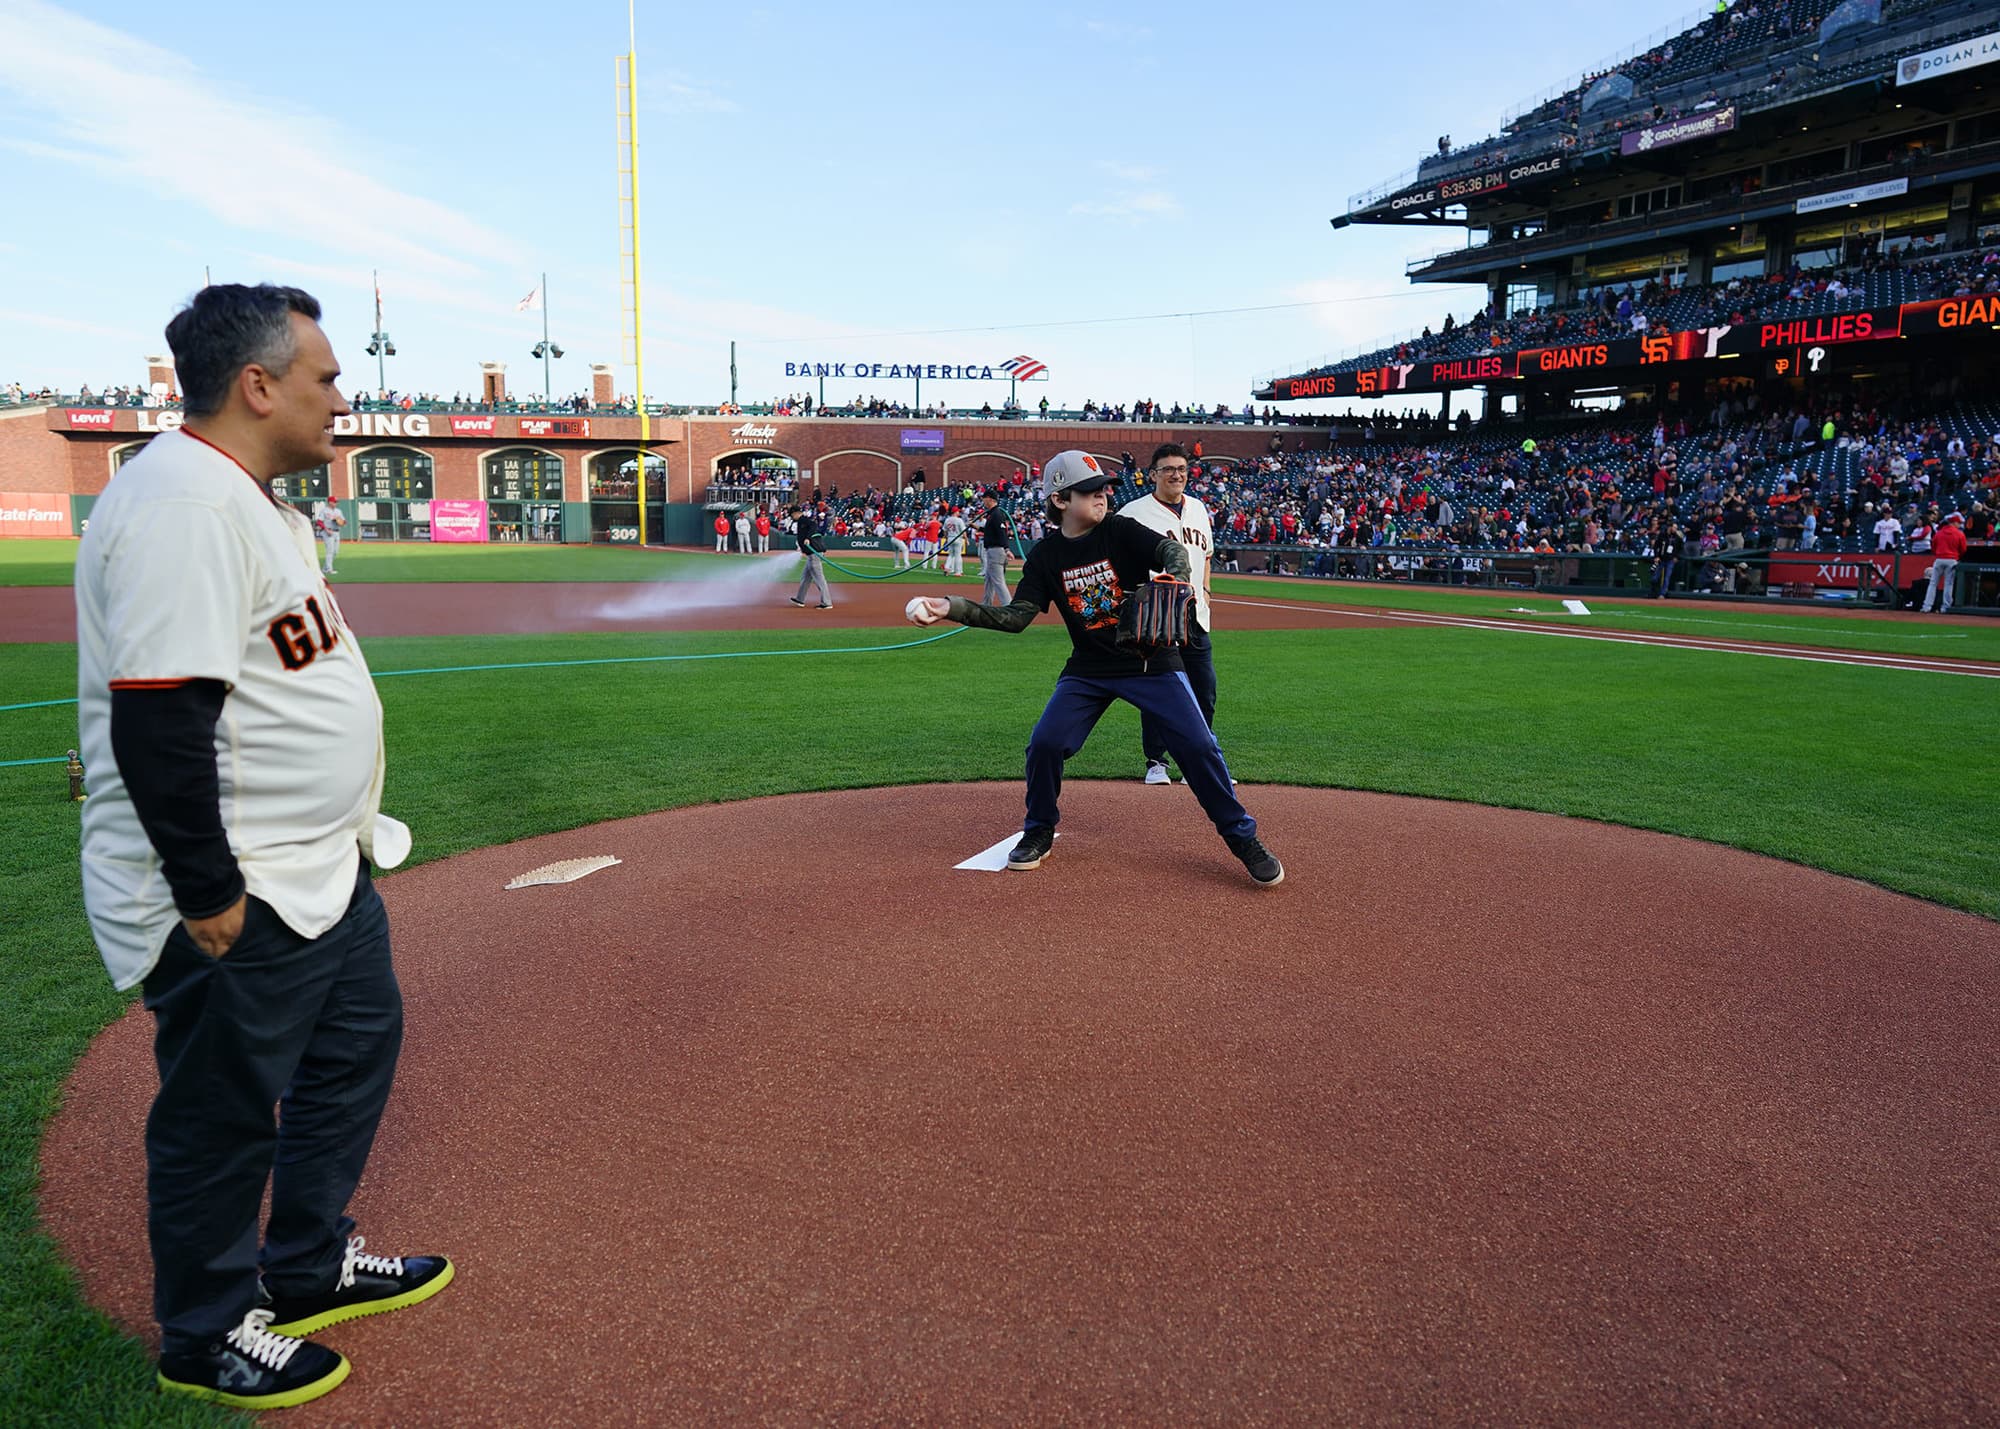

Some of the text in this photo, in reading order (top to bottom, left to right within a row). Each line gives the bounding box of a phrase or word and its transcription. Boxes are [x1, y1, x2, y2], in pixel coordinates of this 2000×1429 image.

[1922, 48, 1973, 70] DOLAN
[1654, 116, 1717, 141] GROUPWARE
[1509, 158, 1561, 180] ORACLE
[1441, 172, 1503, 199] 6:35:36 PM
[1391, 190, 1436, 210] ORACLE
[1799, 198, 1823, 208] ALASKA
[1824, 192, 1854, 204] AIRLINES
[1761, 312, 1873, 347] PHILLIES
[1540, 344, 1607, 370] GIANTS
[785, 362, 993, 379] BANK OF AMERICA
[1432, 357, 1503, 383] PHILLIES
[1290, 376, 1336, 397] GIANTS
[521, 420, 551, 429] SPLASH
[731, 422, 777, 438] Alaska
[504, 460, 519, 470] LAA
[611, 528, 638, 540] 309
[850, 540, 881, 548] ORACLE
[1062, 560, 1110, 581] INFINITE
[1064, 569, 1117, 593] POWER
